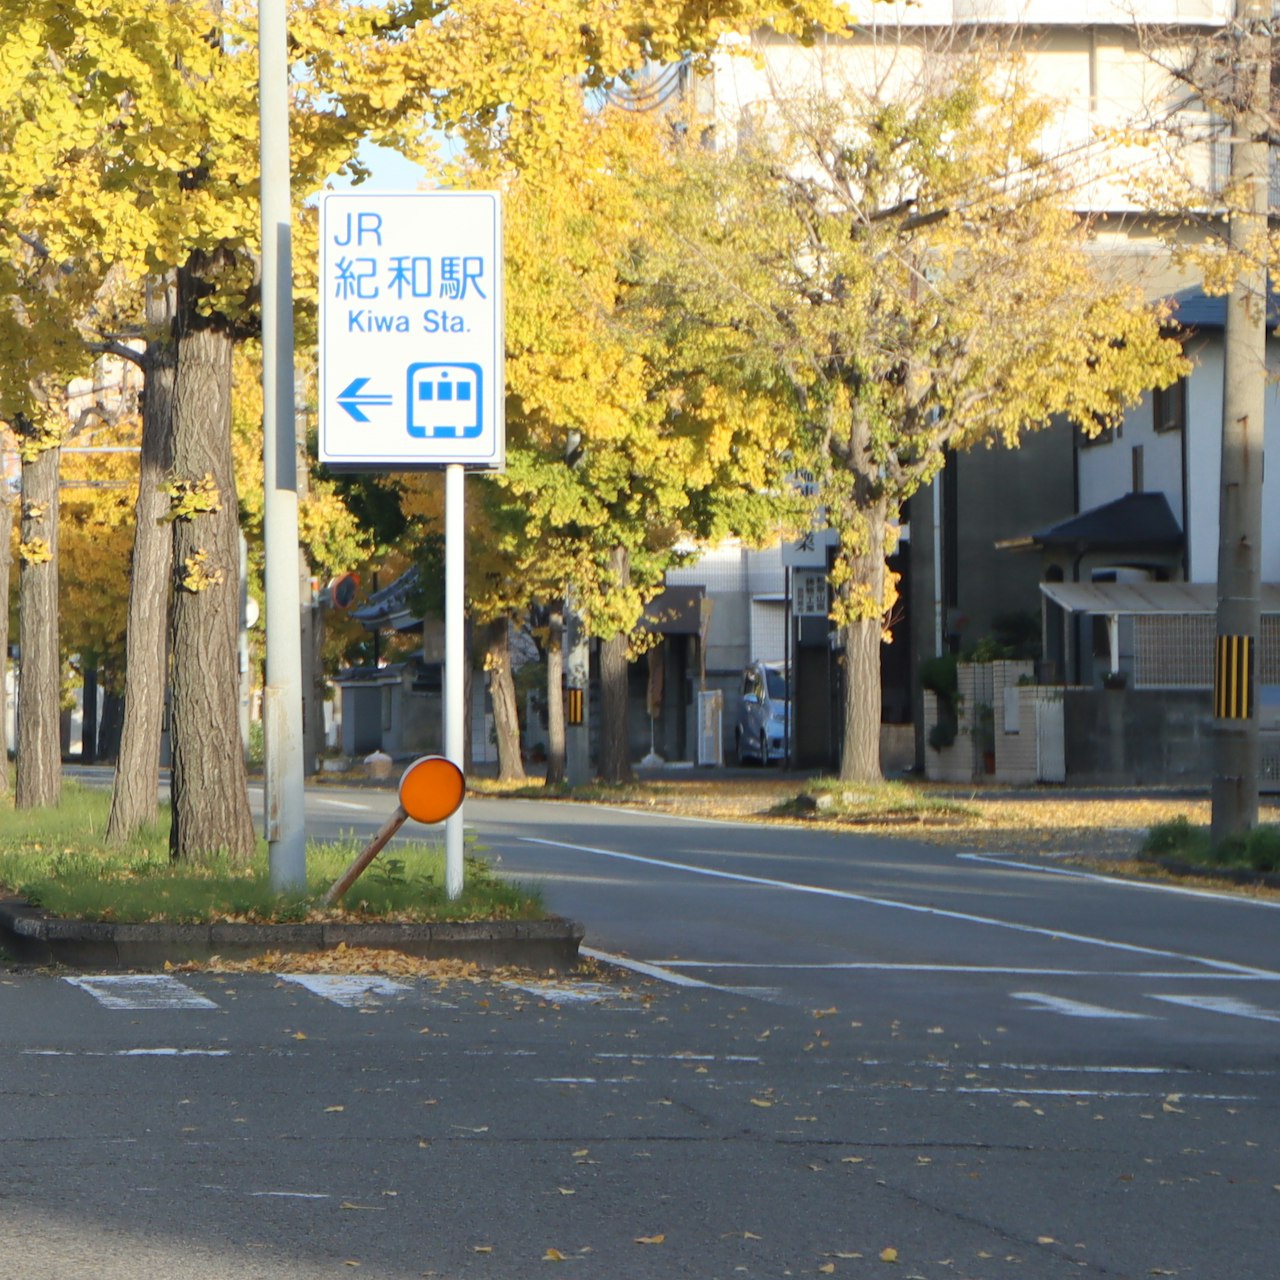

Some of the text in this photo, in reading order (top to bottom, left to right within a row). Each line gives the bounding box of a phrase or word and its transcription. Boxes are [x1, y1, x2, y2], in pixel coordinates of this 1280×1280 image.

[333, 212, 383, 246] JR
[334, 255, 487, 300] 紀和駅
[348, 309, 471, 333] Kiwa Sta.
